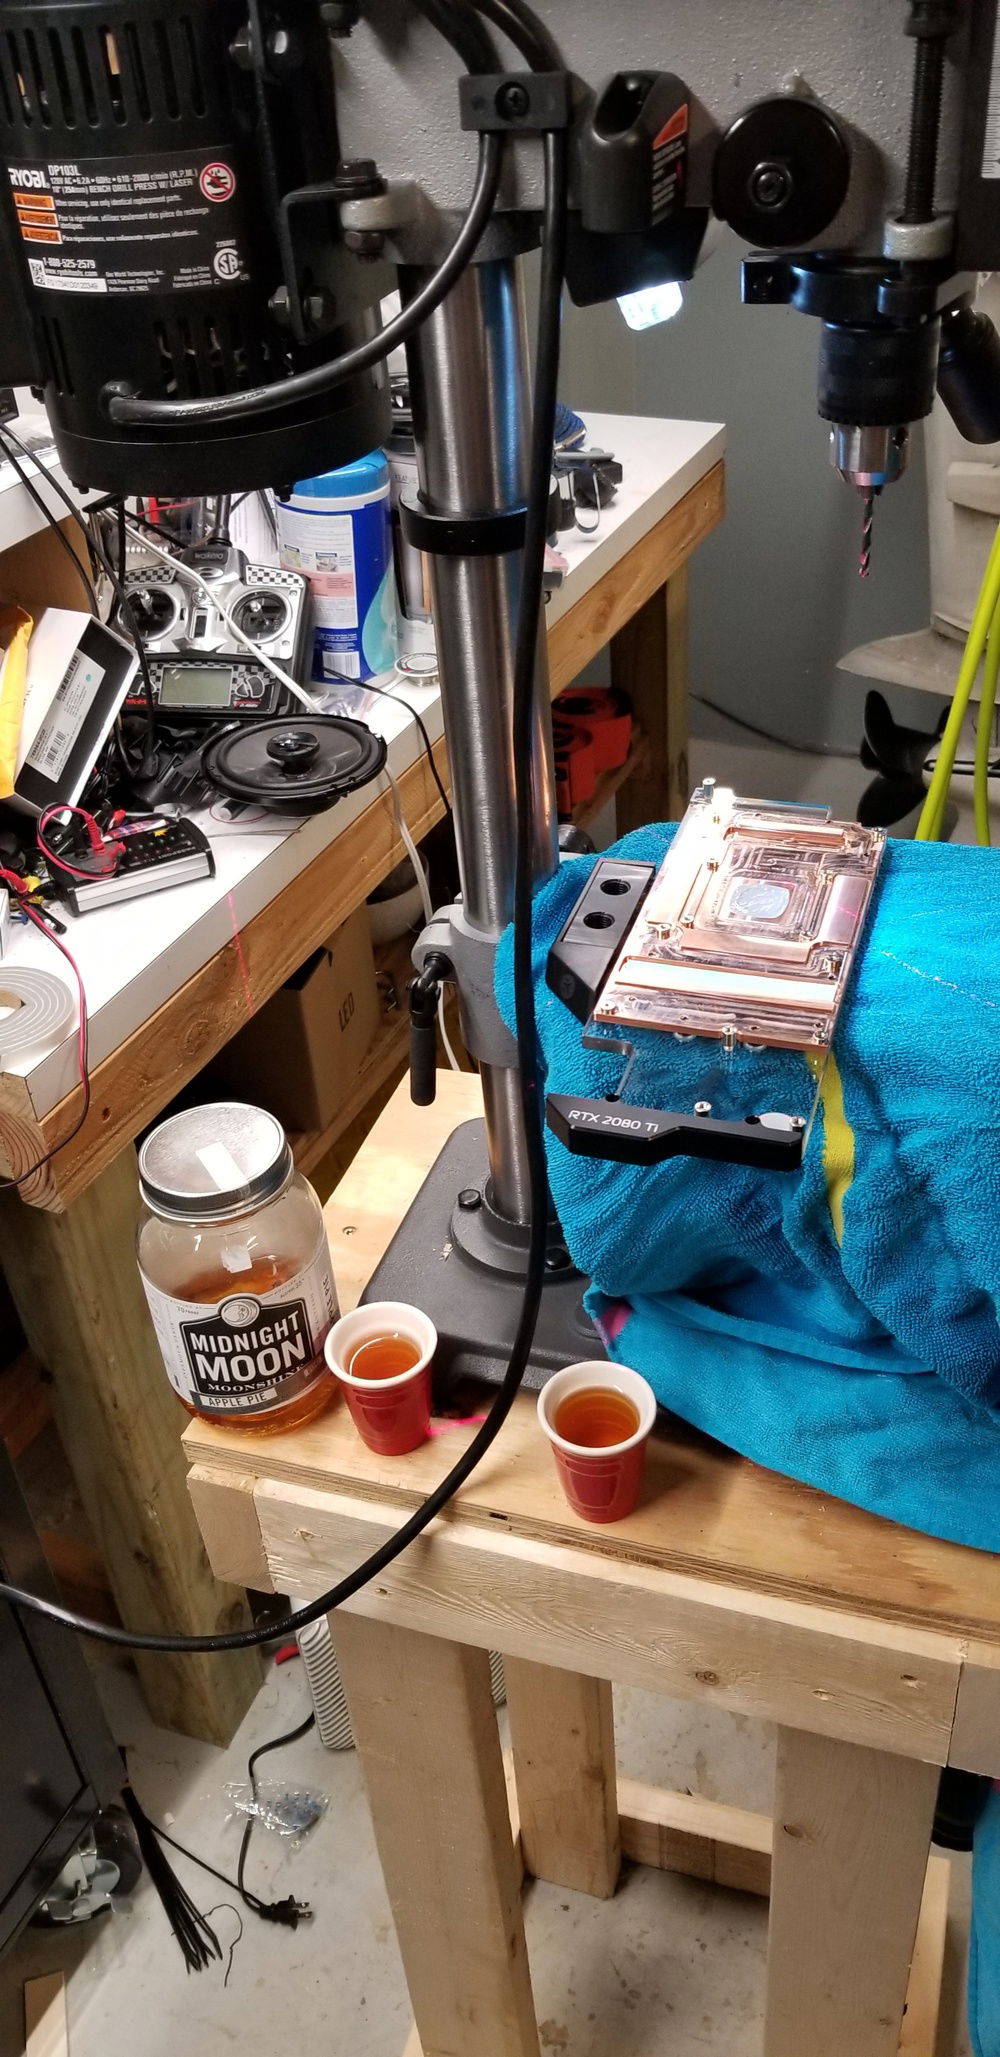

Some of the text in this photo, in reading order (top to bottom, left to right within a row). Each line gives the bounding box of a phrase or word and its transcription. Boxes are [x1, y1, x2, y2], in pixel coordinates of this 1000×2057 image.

[8, 167, 49, 189] RYOBI
[47, 164, 82, 176] DP103L
[133, 181, 158, 191] PRESS
[169, 177, 194, 188] LASER
[338, 991, 355, 1033] LED
[568, 1109, 601, 1123] RTX
[601, 1115, 641, 1130] 2080
[189, 1311, 300, 1354] MIDNIGHT
[195, 1334, 306, 1383] MOON
[208, 1392, 268, 1407] APPLE PIE
